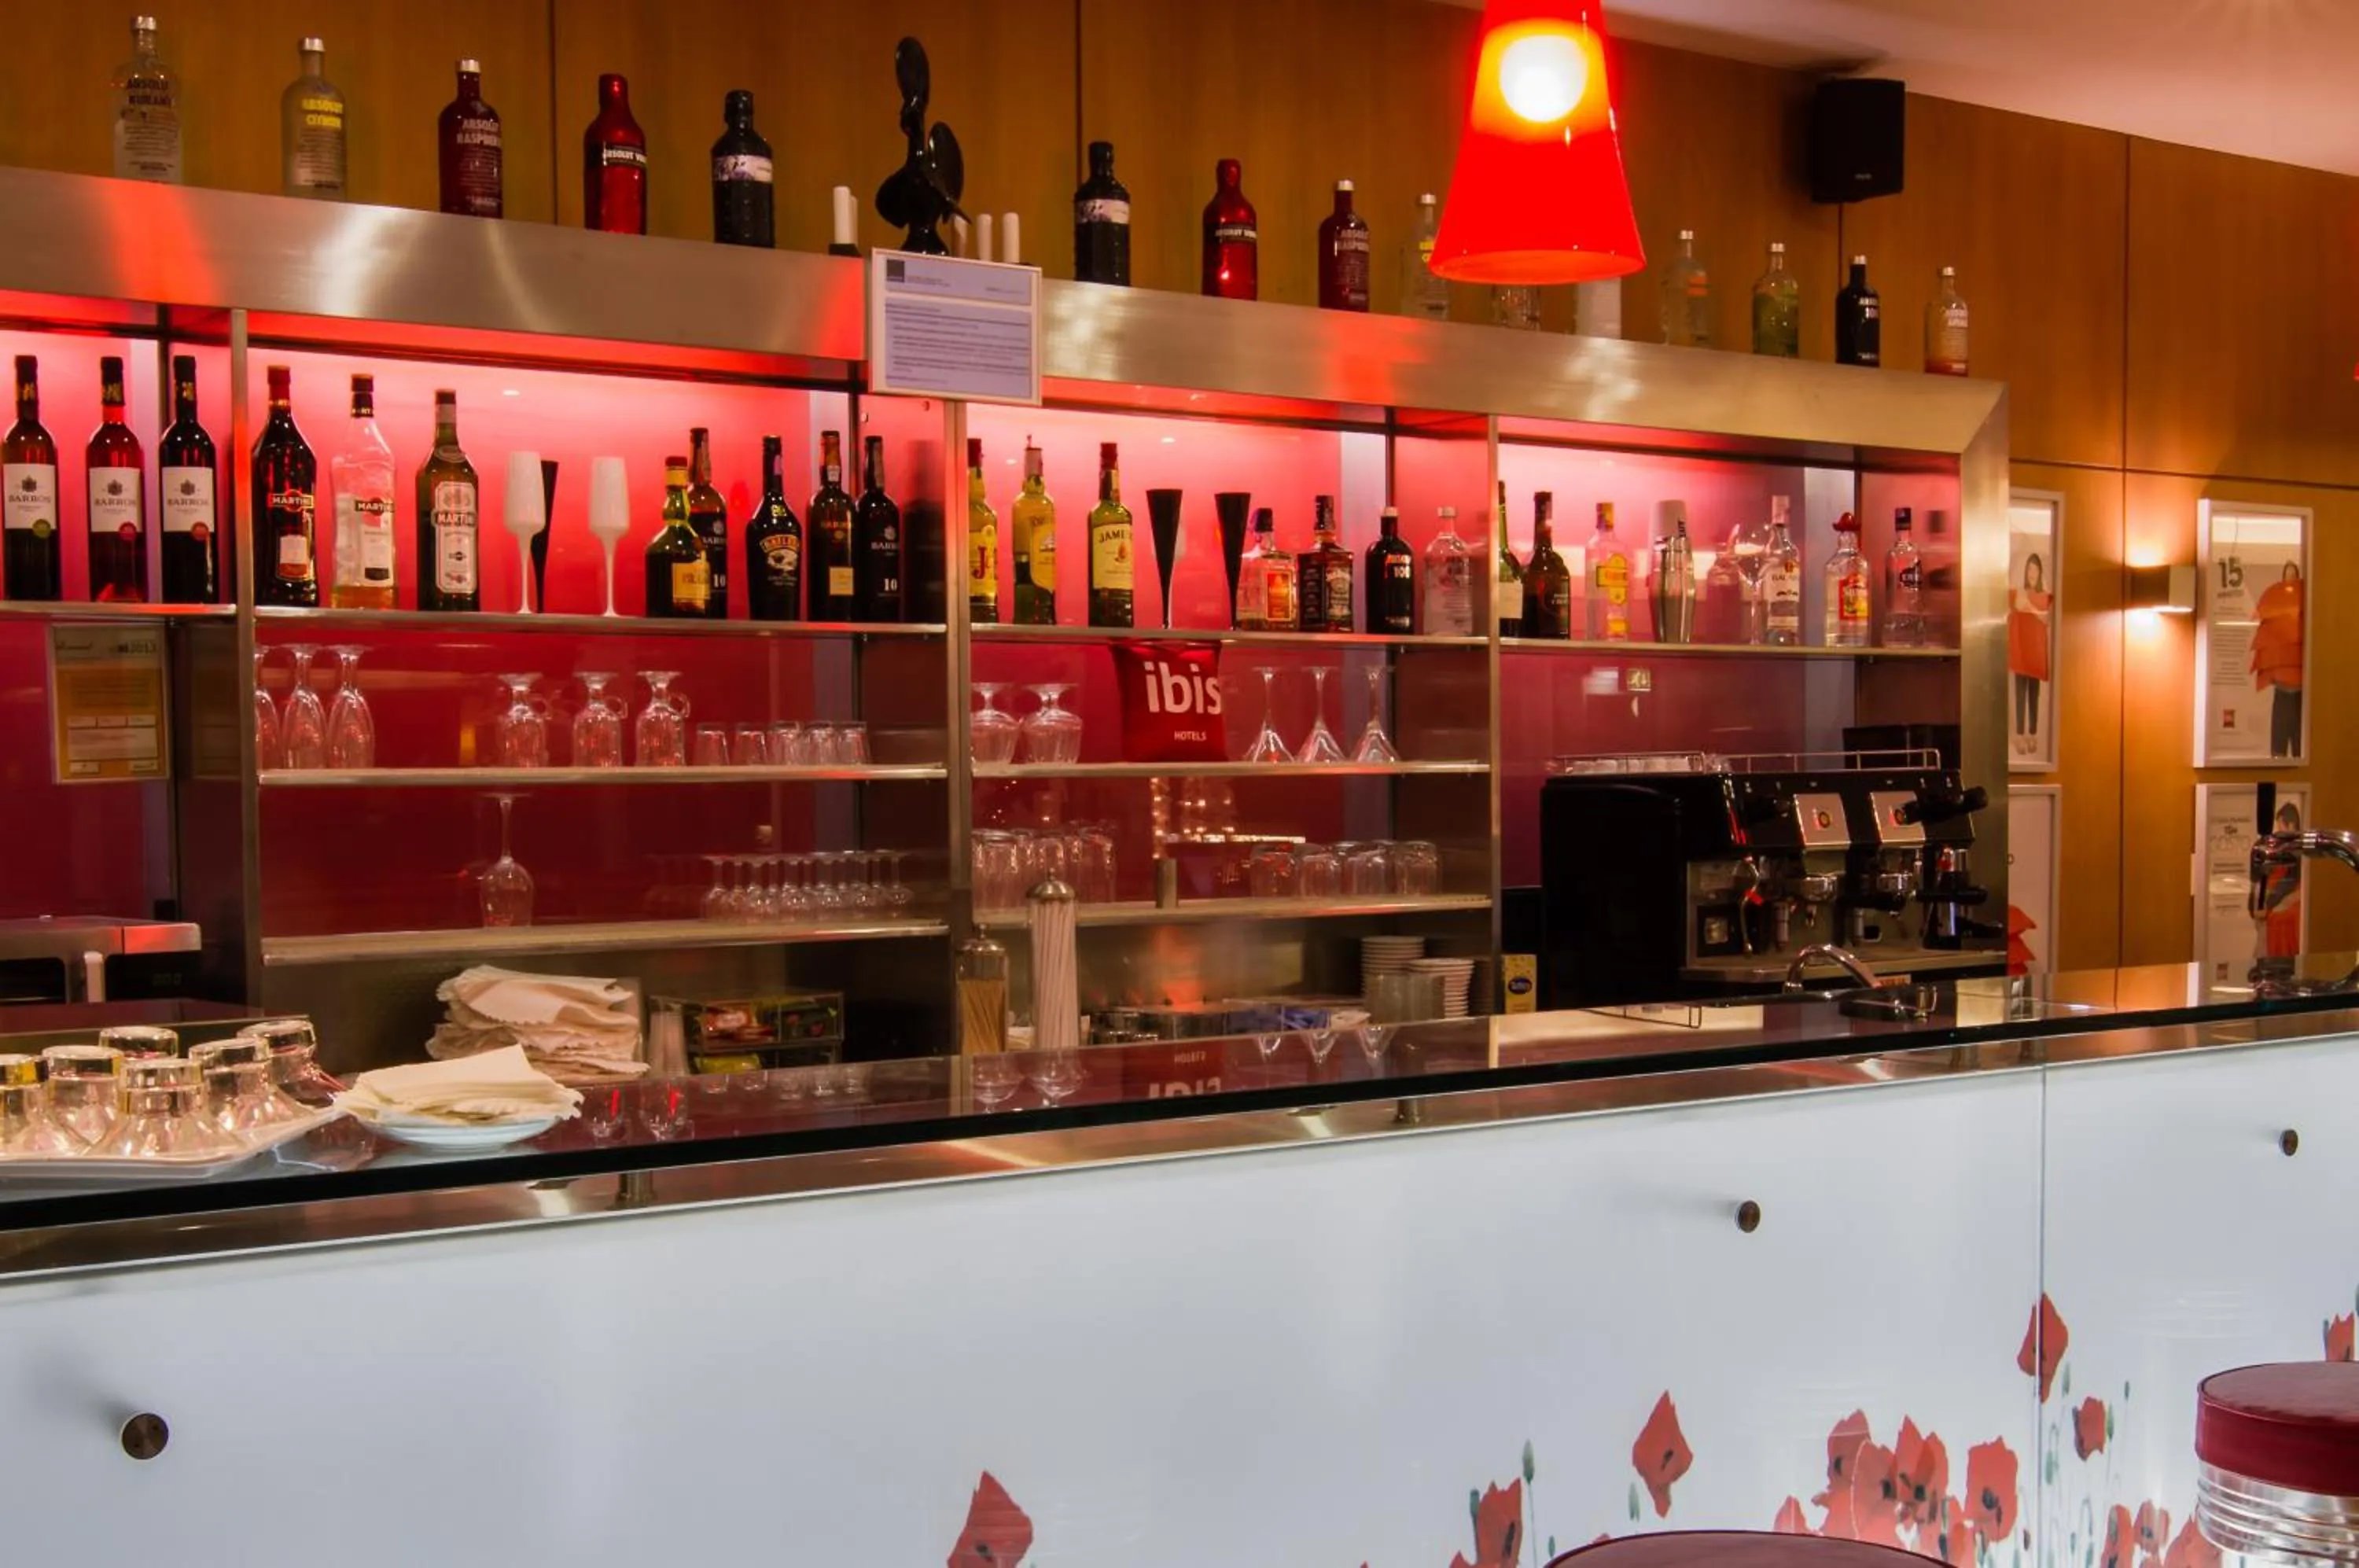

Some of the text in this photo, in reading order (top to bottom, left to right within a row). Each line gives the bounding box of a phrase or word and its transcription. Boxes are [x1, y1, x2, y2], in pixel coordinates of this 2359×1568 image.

[2217, 556, 2244, 588] 15
[1143, 660, 1222, 715] ibis
[1174, 730, 1207, 742] HOTELS
